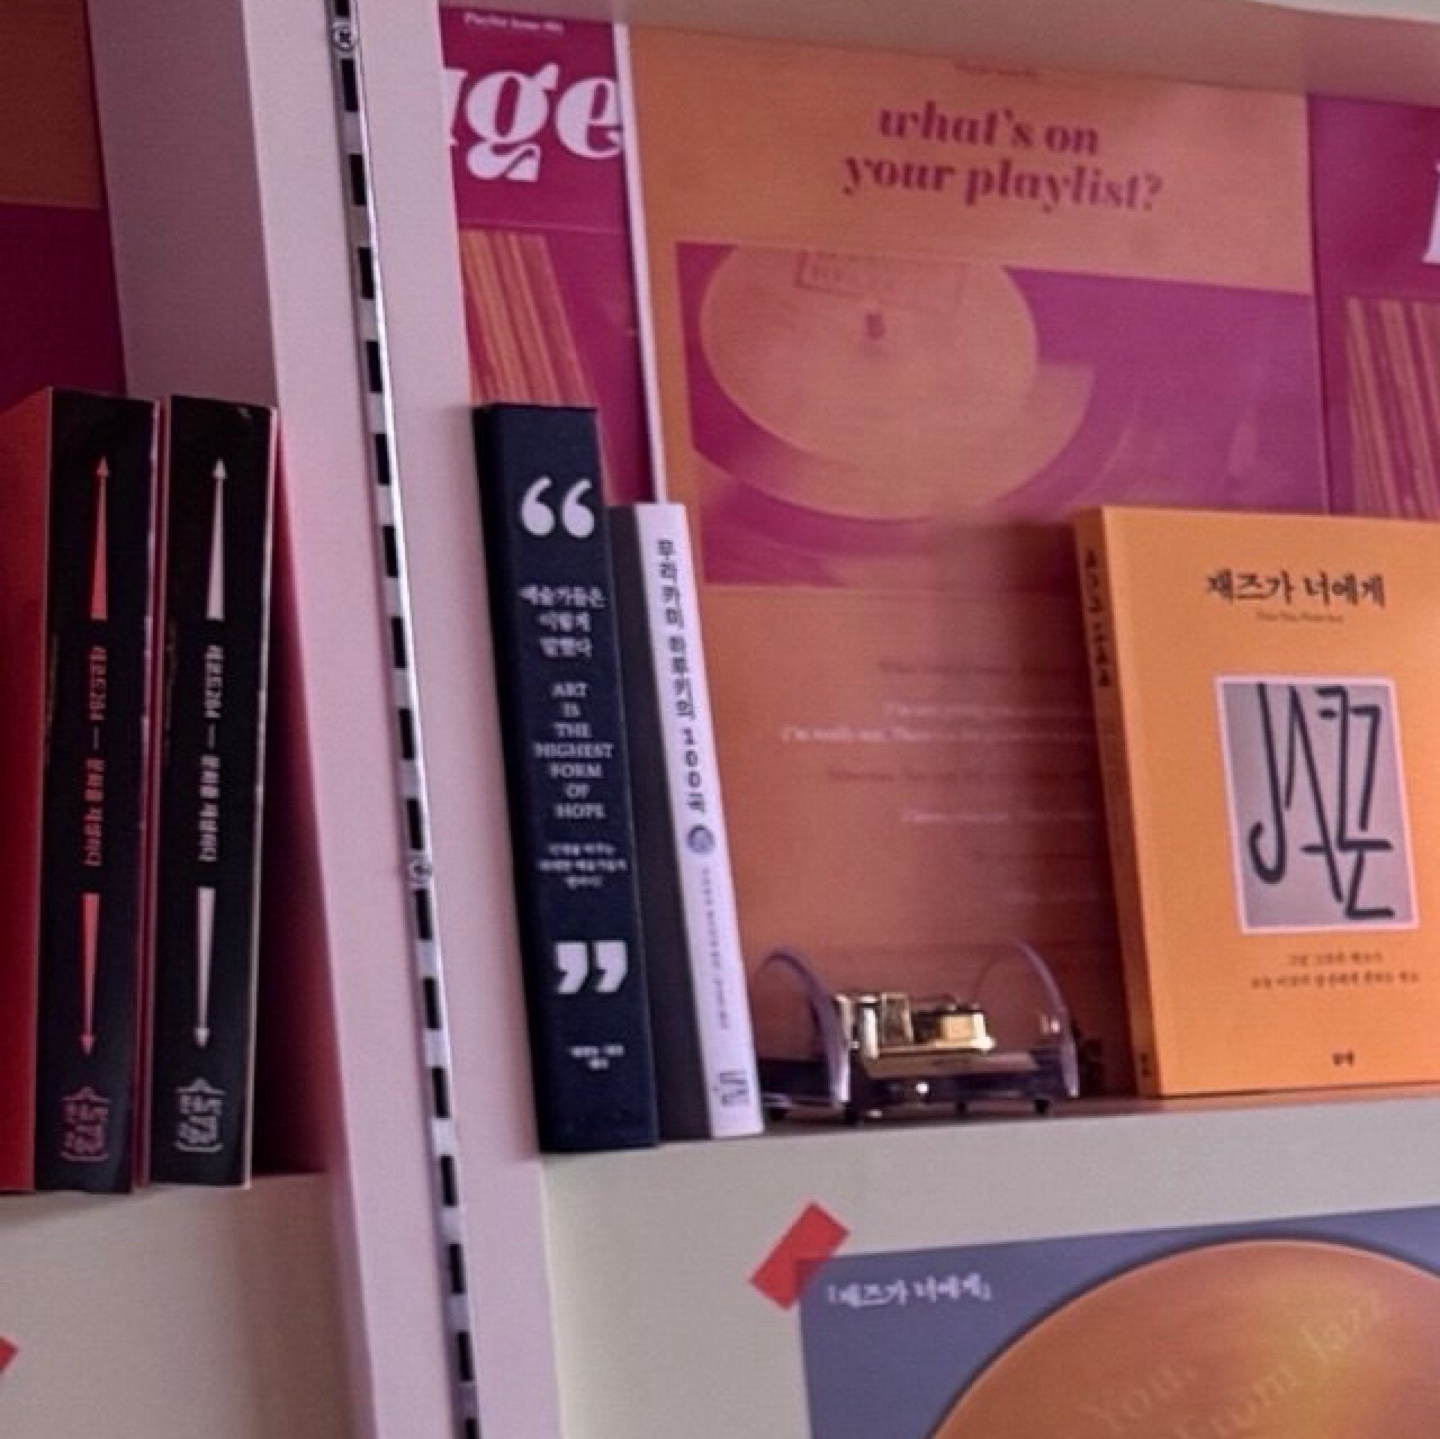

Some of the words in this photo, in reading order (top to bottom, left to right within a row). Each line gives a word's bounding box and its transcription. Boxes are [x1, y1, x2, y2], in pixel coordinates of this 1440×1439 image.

[879, 100, 1034, 151] what's
[1045, 127, 1100, 157] on
[843, 156, 956, 196] your
[964, 158, 1164, 214] playlist?
[1206, 567, 1296, 606] 재즈가
[1303, 569, 1386, 609] 너에게
[551, 681, 588, 698] ART
[561, 702, 581, 718] IS
[553, 723, 591, 739] THE
[533, 742, 615, 760] HIGHEST
[550, 763, 603, 779] FORM
[565, 783, 591, 799] OF
[554, 803, 607, 820] HOPE
